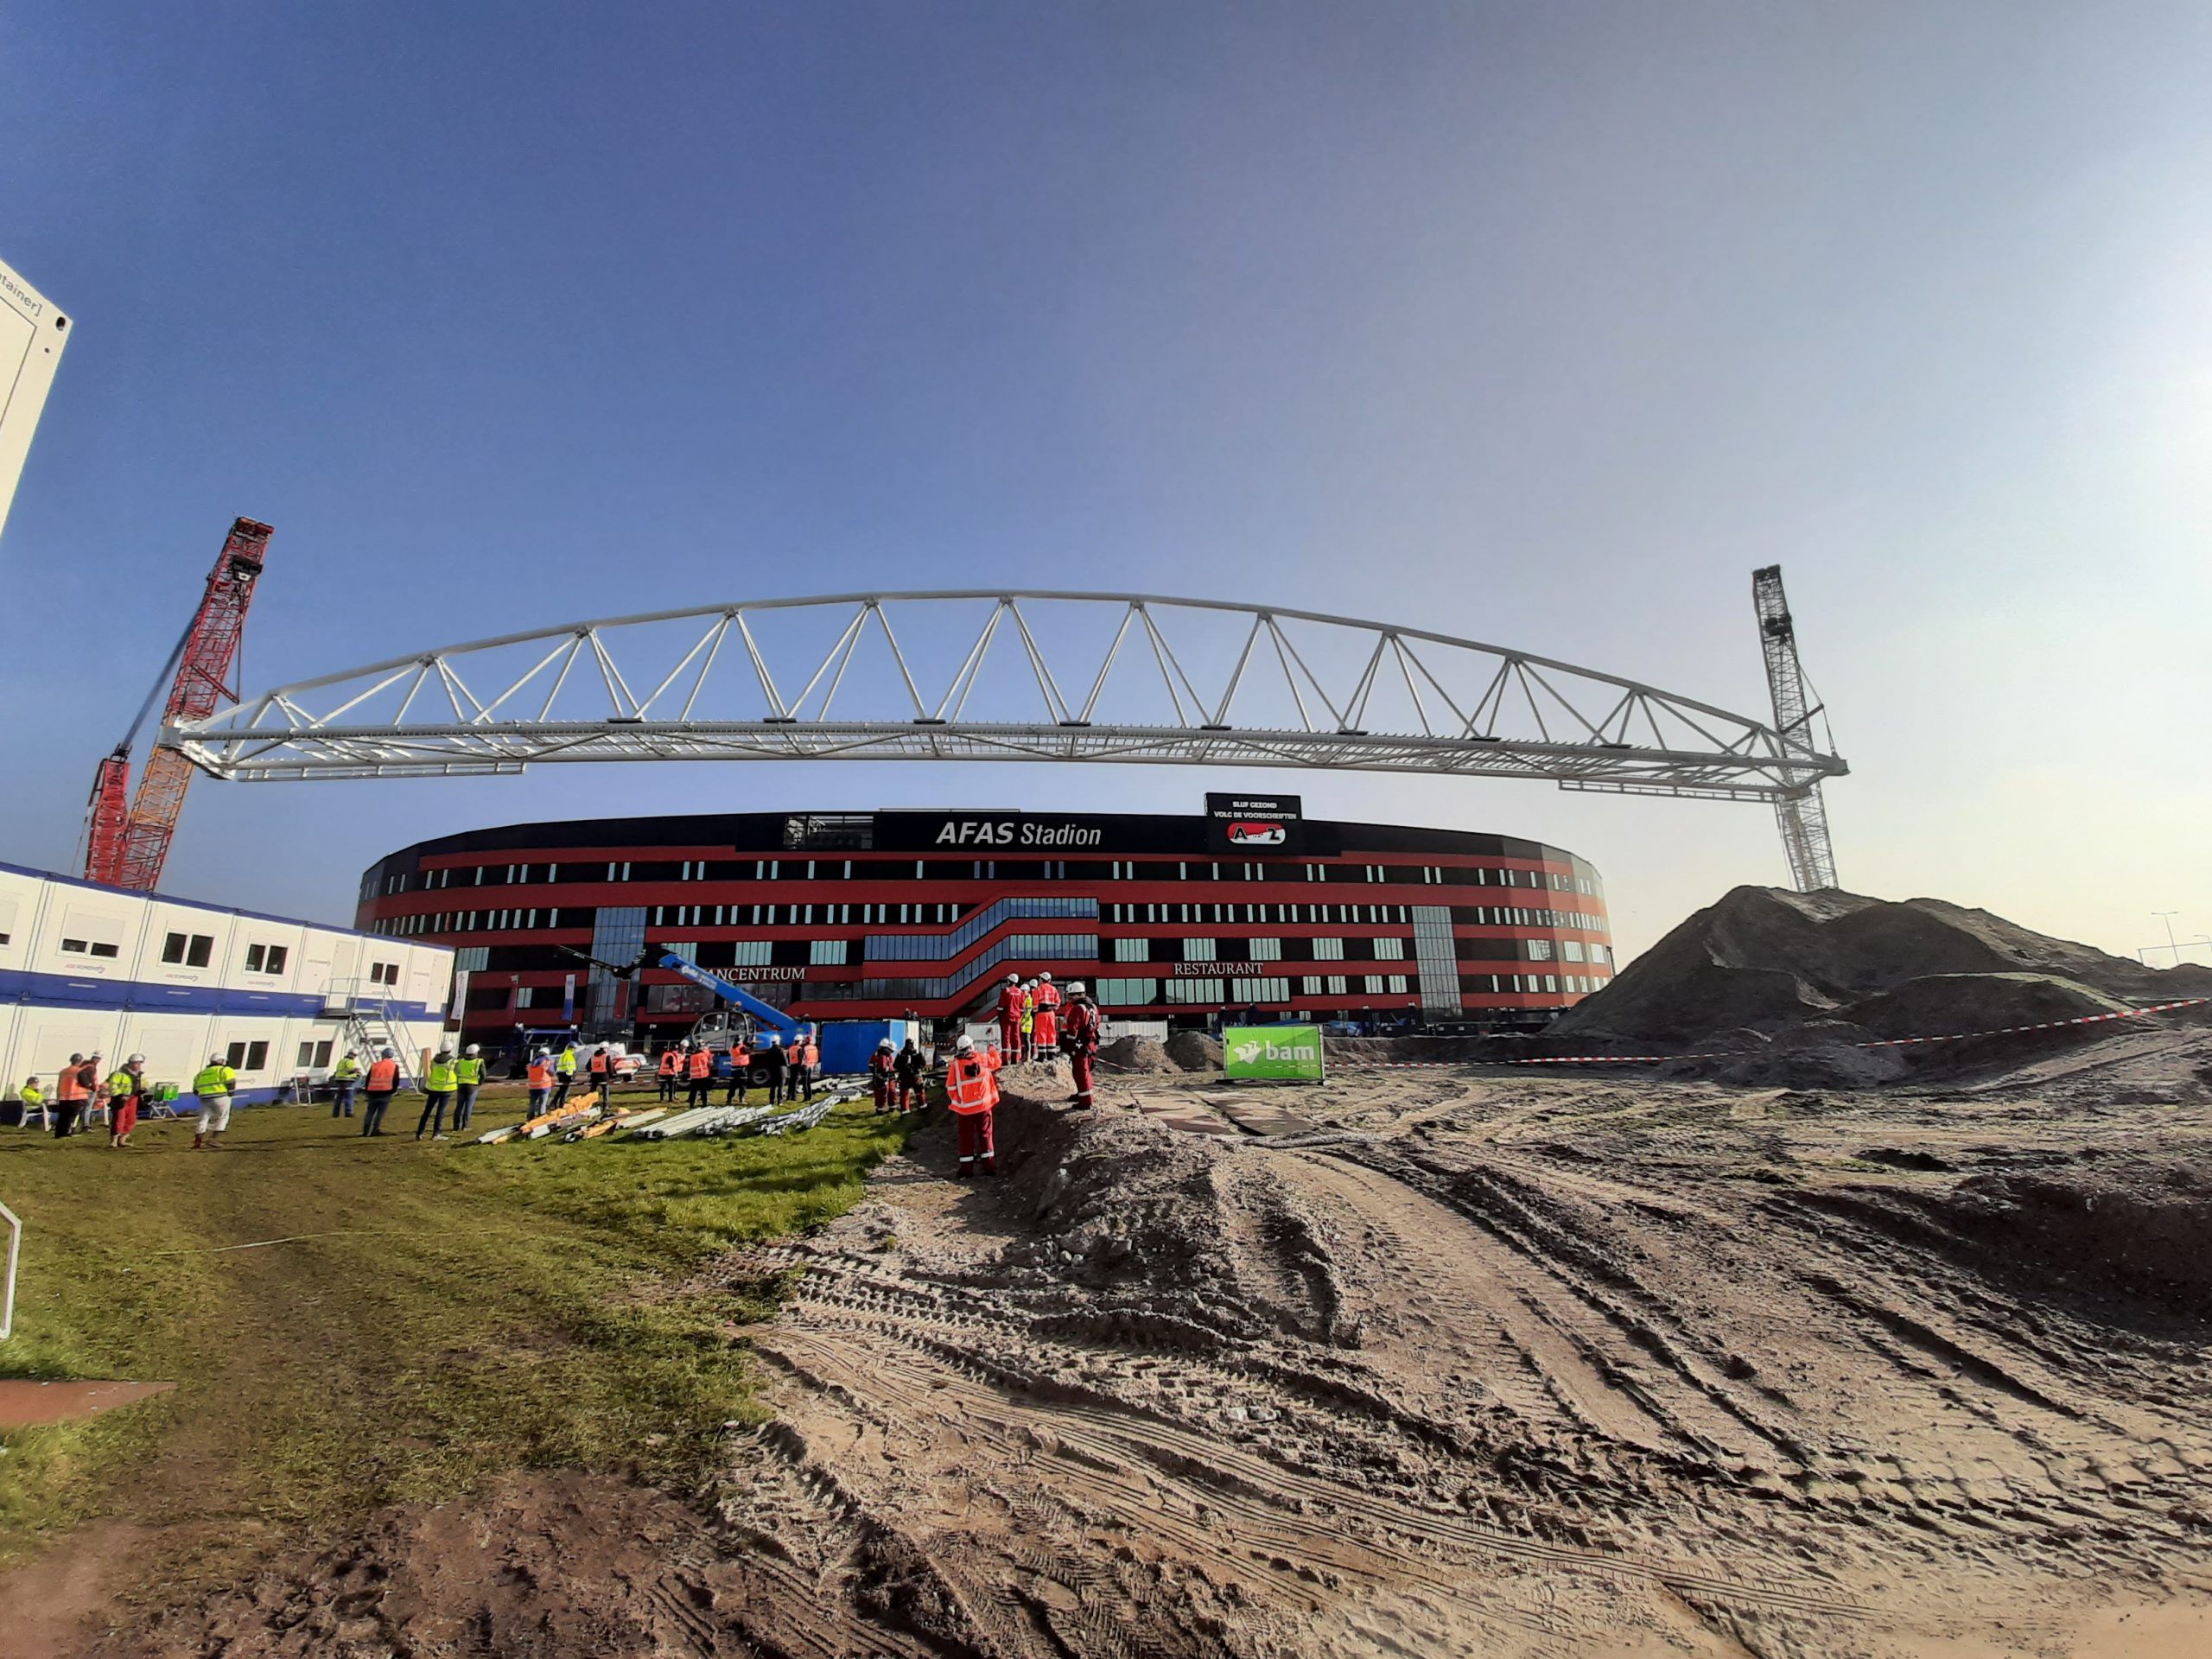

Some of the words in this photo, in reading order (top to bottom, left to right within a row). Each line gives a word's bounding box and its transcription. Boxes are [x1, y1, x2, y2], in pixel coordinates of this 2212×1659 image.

[0, 273, 42, 317] tainer]
[935, 822, 1014, 844] AFAS
[1020, 823, 1101, 845] Stadion
[1174, 962, 1263, 976] RESTAURANT
[1265, 1039, 1314, 1061] bam
